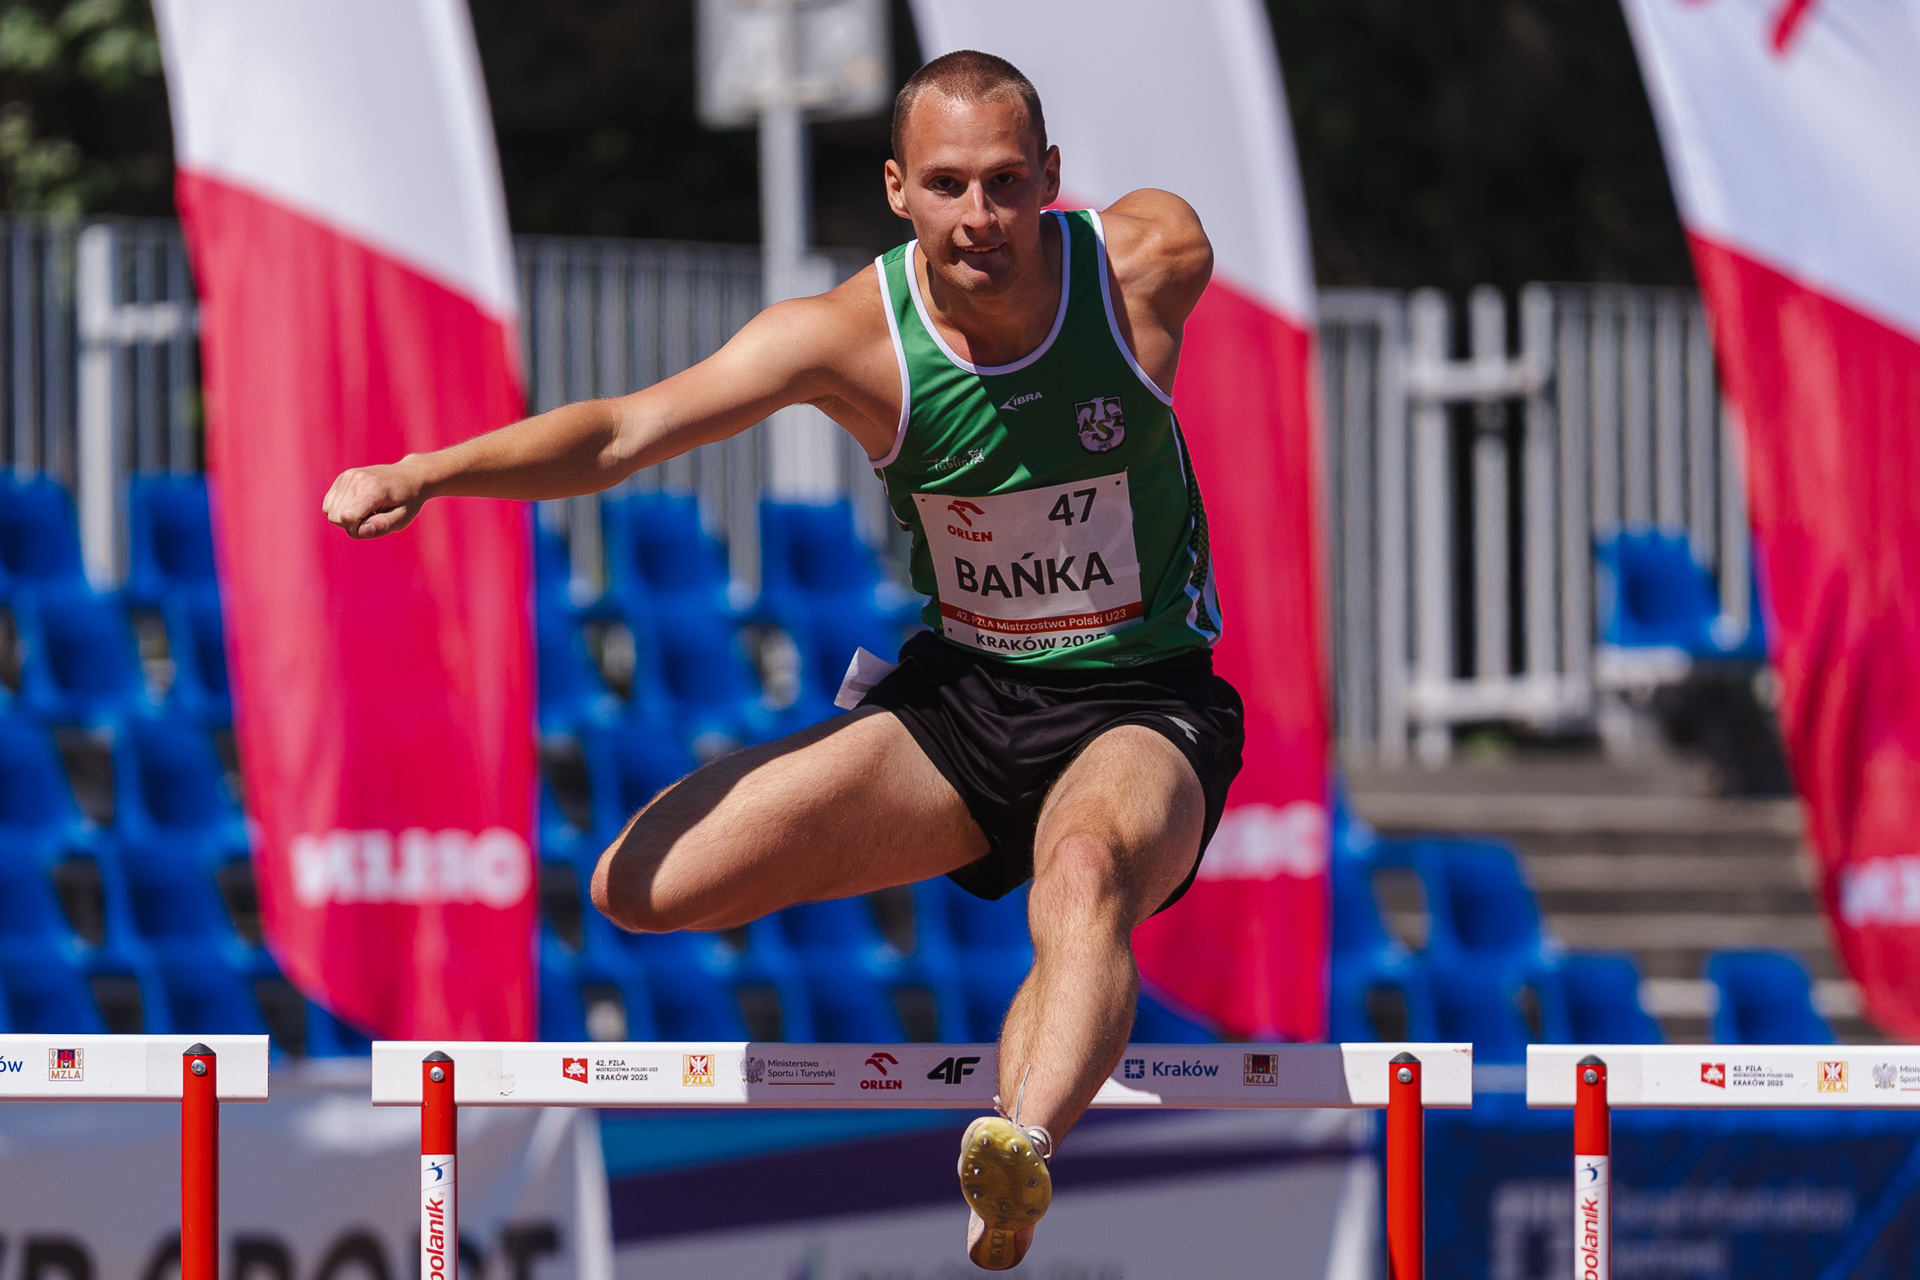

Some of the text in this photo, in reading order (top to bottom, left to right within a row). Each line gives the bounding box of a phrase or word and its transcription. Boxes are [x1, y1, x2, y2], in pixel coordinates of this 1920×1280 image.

[1048, 487, 1097, 526] 47
[947, 524, 993, 543] ORLEN
[954, 551, 1115, 599] BAŃKA
[956, 608, 1127, 631] 42. PZLA Mistrzostwa Polski U23
[975, 632, 1056, 651] KRAKÓW
[767, 1059, 819, 1067] Ministerstwo
[927, 1056, 981, 1084] 4F
[1152, 1060, 1219, 1077] Kraków
[51, 1070, 81, 1079] MZLA
[596, 1073, 629, 1081] KRAKÓW
[768, 1069, 794, 1079] Sportu
[800, 1069, 836, 1079] Turystyki
[684, 1075, 713, 1085] PZLA
[1246, 1075, 1275, 1084] MZLA
[860, 1080, 902, 1090] ORLEN
[1820, 1082, 1846, 1091] PZLA
